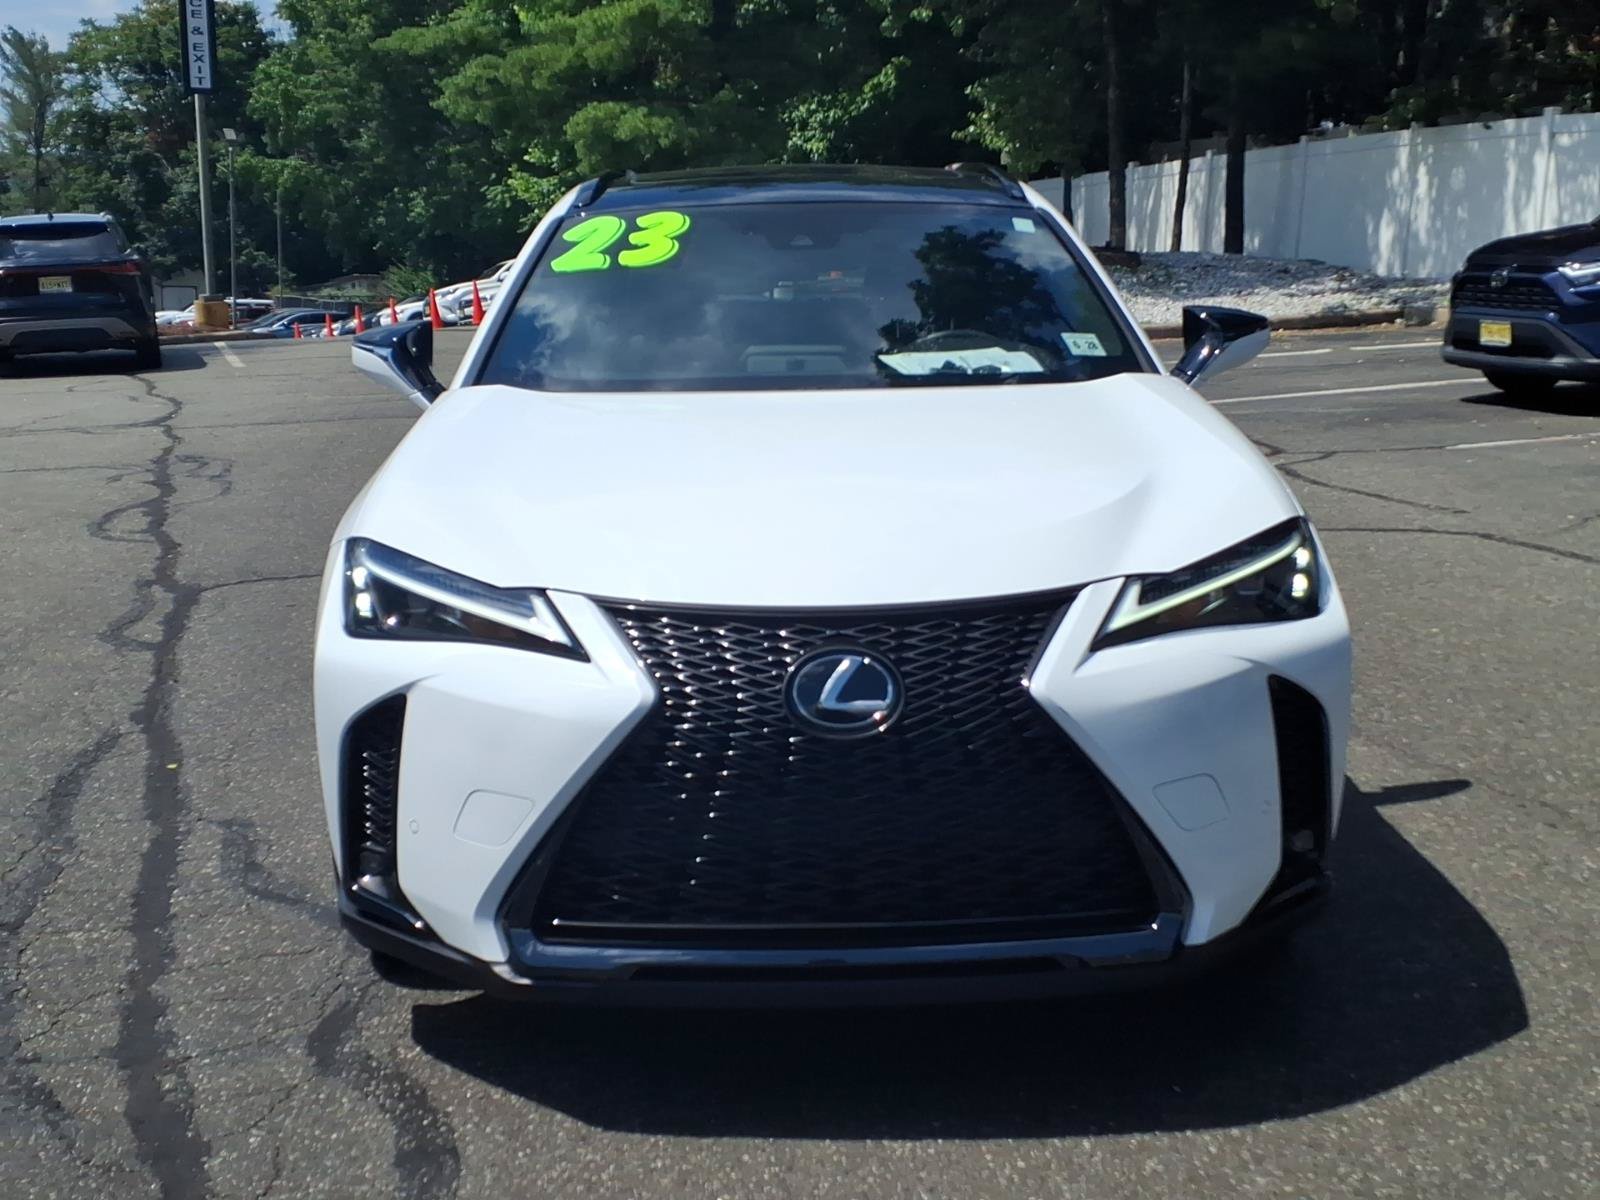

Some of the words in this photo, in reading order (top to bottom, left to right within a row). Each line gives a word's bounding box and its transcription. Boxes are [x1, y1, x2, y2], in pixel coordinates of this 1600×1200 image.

[191, 26, 204, 35] &
[192, 42, 207, 86] EXIT
[550, 210, 690, 272] 23
